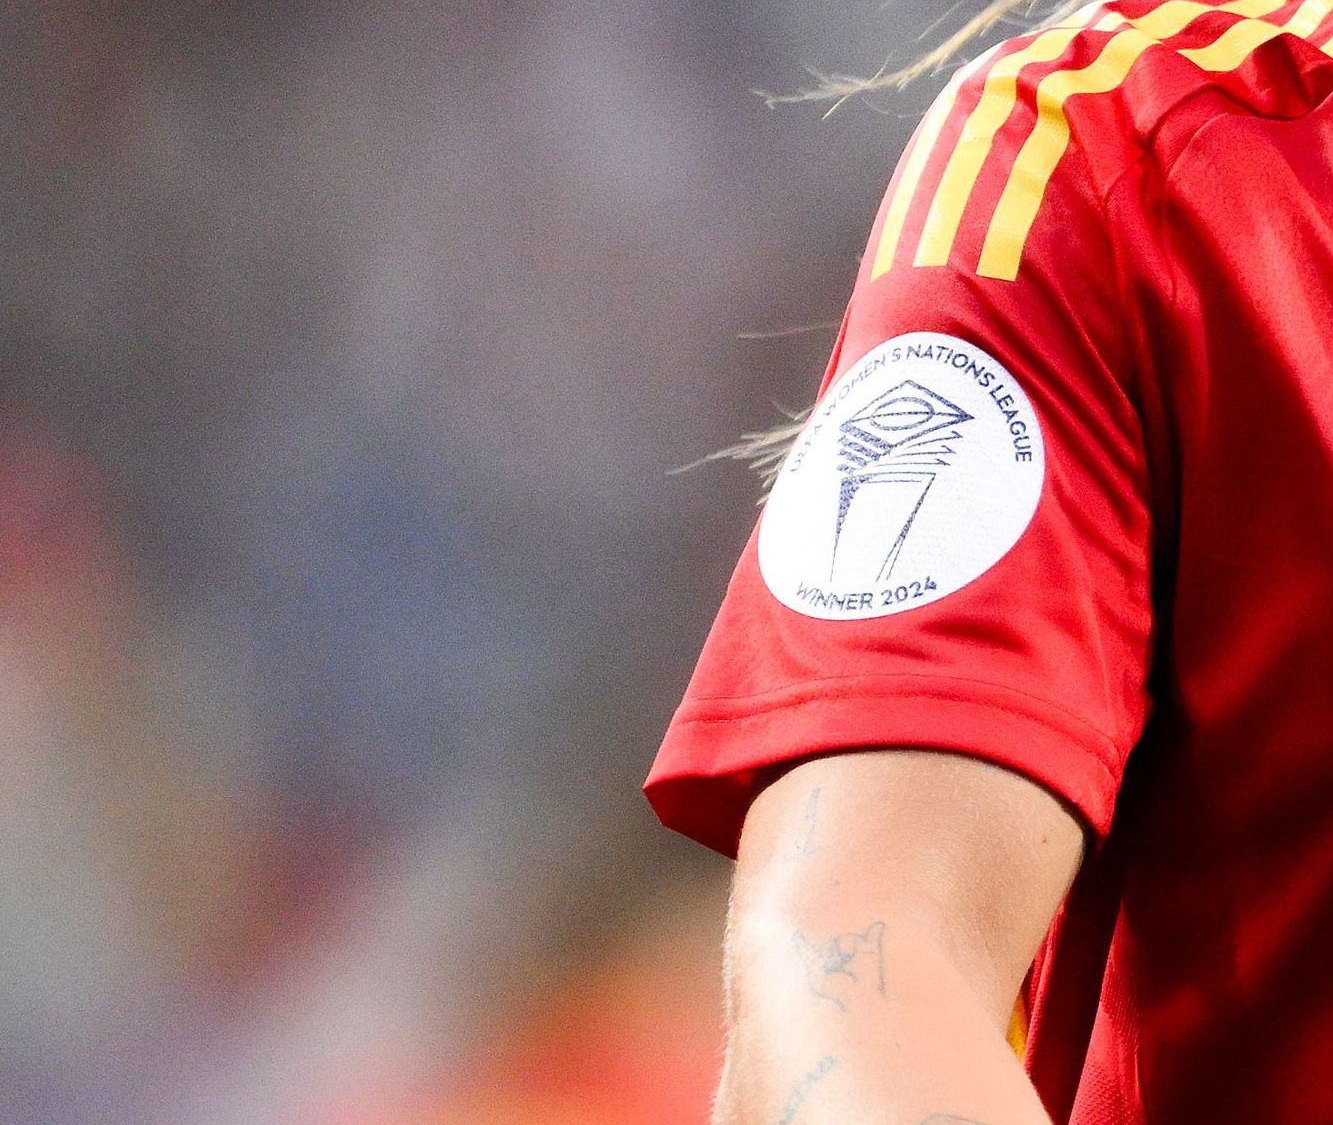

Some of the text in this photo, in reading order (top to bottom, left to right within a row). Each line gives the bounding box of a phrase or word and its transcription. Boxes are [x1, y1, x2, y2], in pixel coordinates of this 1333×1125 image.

[907, 344, 995, 388] NATIONS
[989, 385, 1032, 463] LEAGUE
[796, 575, 937, 610] WINNER 2024
